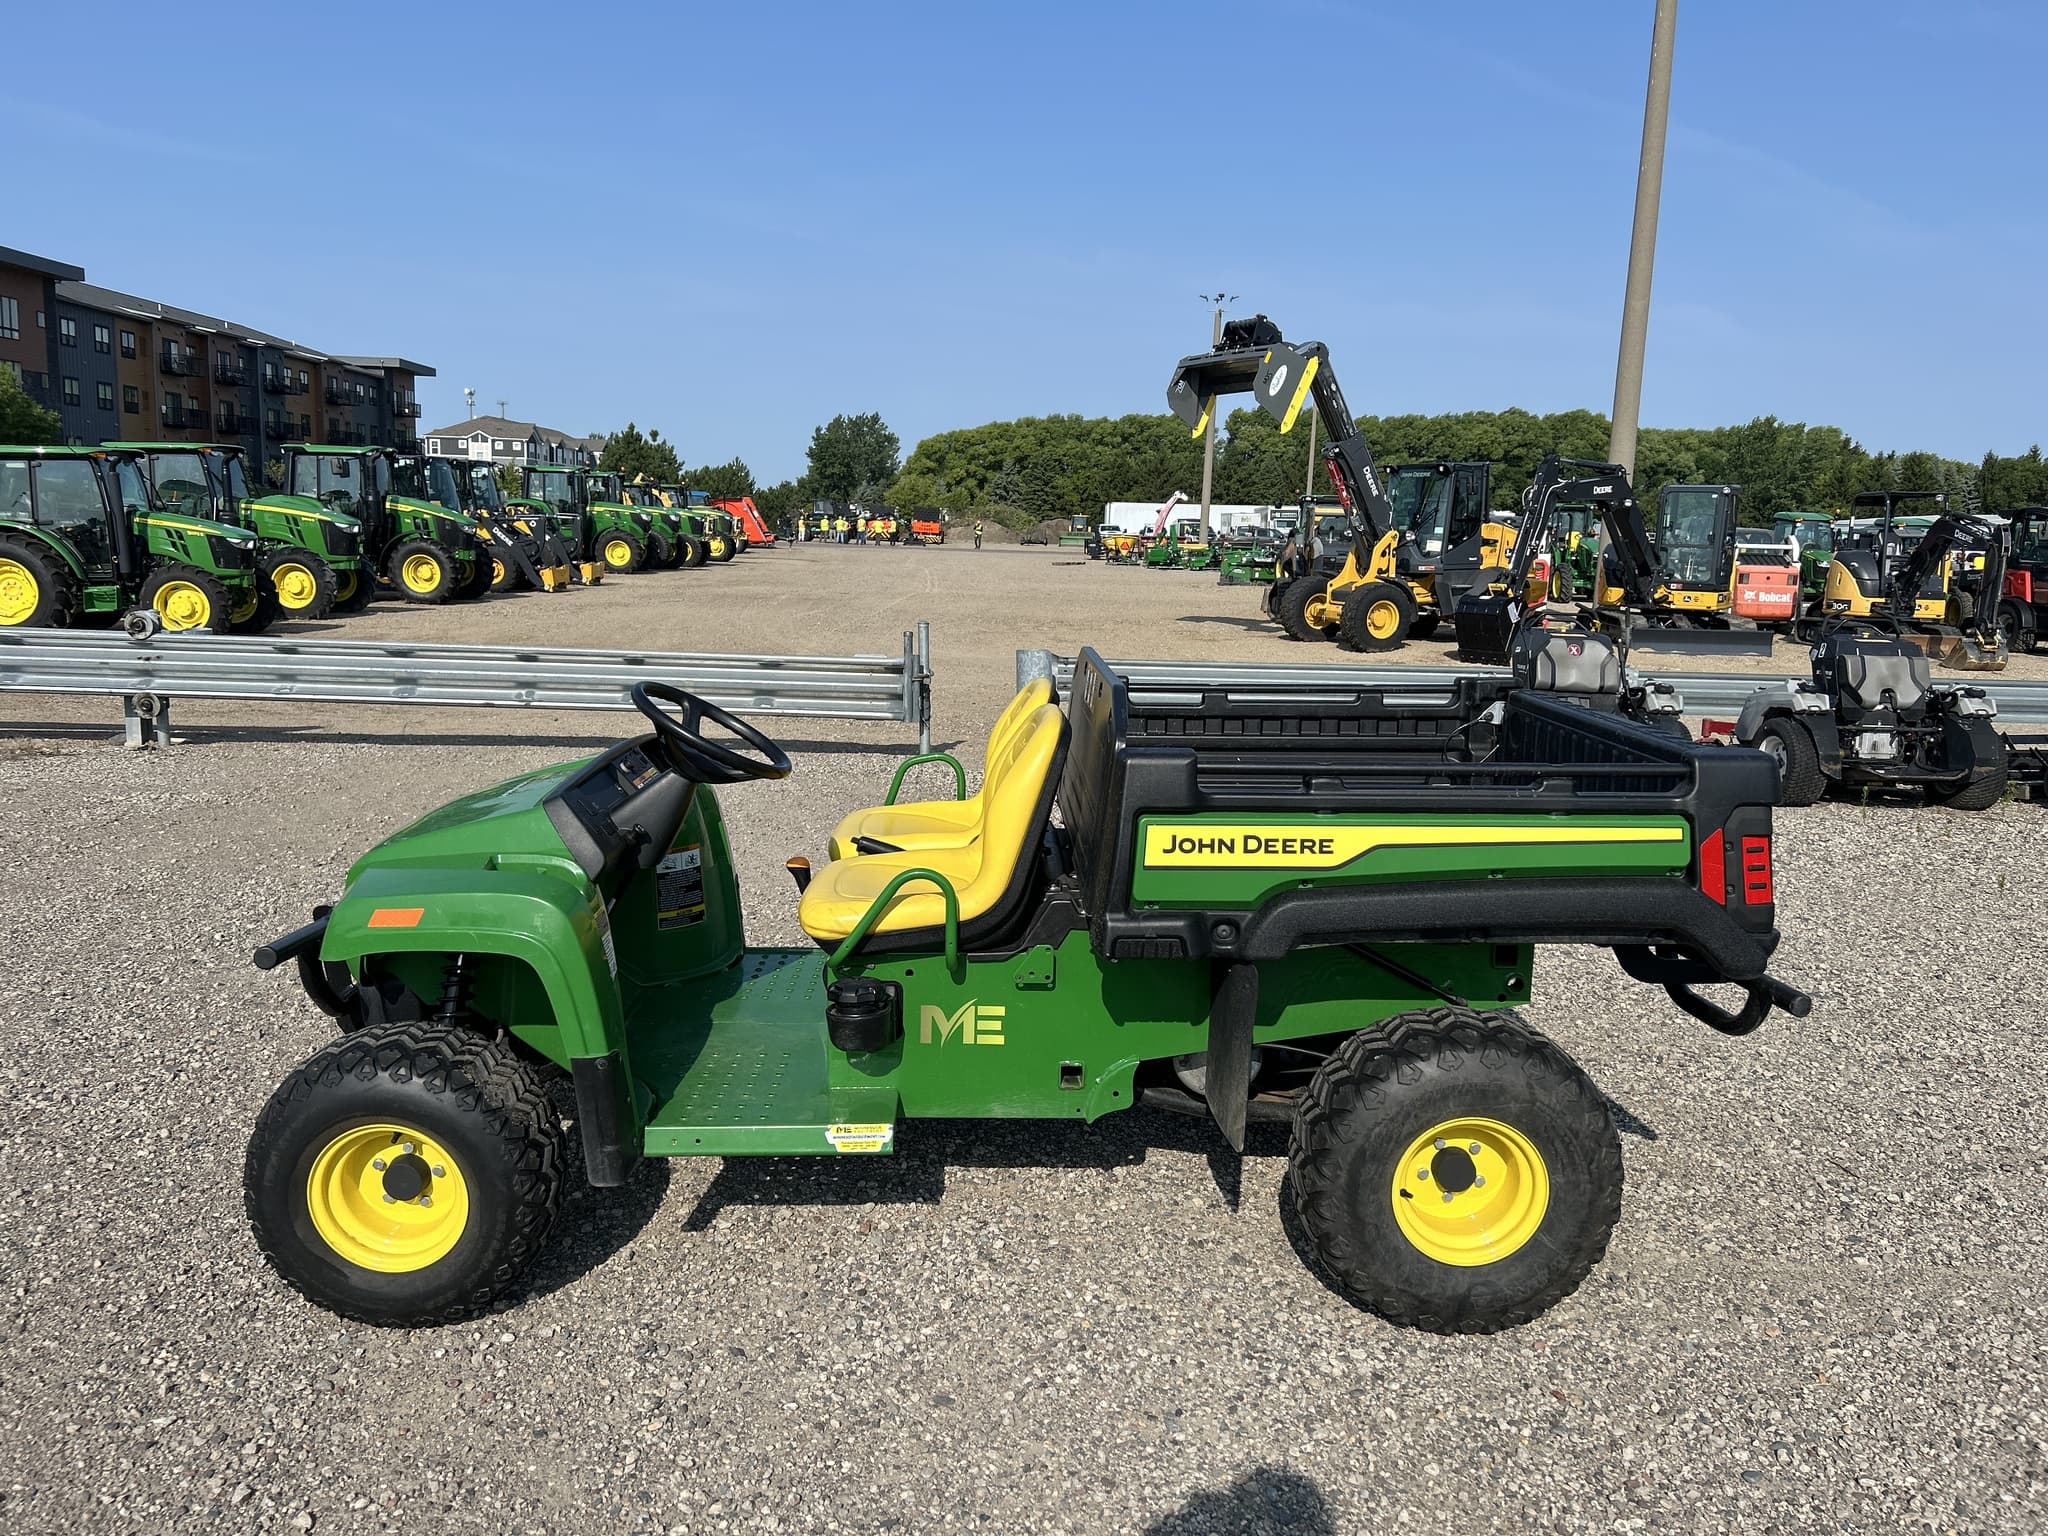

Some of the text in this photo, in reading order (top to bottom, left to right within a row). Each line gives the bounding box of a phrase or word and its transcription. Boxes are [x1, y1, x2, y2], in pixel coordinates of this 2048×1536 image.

[1363, 466, 1379, 497] DEERE
[492, 526, 514, 547] DEERE
[1954, 529, 1974, 544] DEERE
[1758, 591, 1791, 603] Bobcat
[1162, 834, 1335, 855] JOHN DEERE
[920, 998, 1006, 1049] ME
